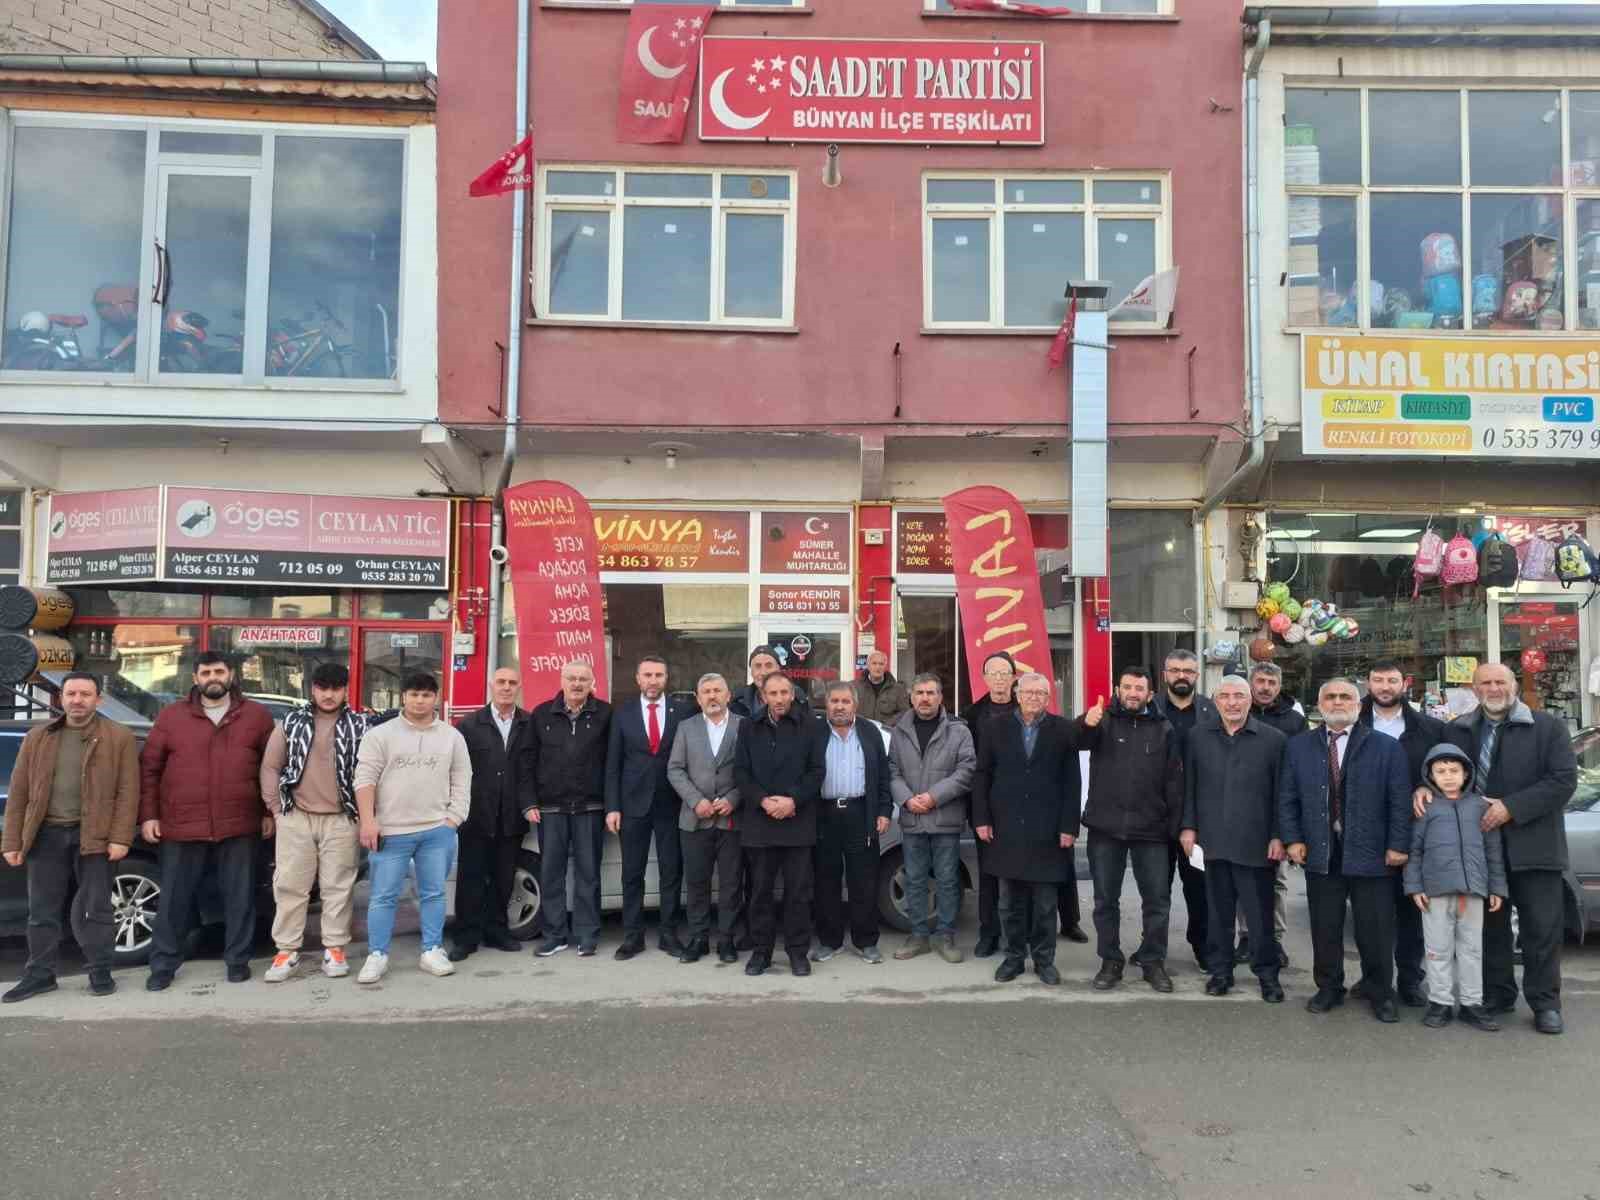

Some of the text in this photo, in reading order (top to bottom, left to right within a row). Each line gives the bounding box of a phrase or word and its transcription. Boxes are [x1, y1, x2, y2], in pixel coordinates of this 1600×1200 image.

[790, 47, 1033, 100] SAADET PARTİSİ
[793, 107, 1032, 134] BÜNYAN İLÇE TEŞKİLATI
[1318, 338, 1431, 387] ÜNAL
[1552, 402, 1585, 416] PVC
[1327, 428, 1466, 447] RENKLİ FOTOKOPİ
[1483, 428, 1495, 449] 0
[1502, 428, 1540, 449] 535
[1545, 429, 1583, 450] 379
[319, 511, 399, 533] CEYLAN
[172, 552, 260, 565] Alper CEYLAN
[620, 555, 649, 567] 863
[655, 555, 674, 568] 78
[679, 556, 698, 568] 57
[791, 551, 840, 560] MAHALLE
[175, 565, 255, 577] 0536 451 25 80
[279, 562, 343, 575] 712 05 09
[355, 559, 440, 572] Orhan CEYLAN
[786, 560, 847, 571] MUHTARLIĞI
[361, 571, 435, 583] 0535 283 20 70
[800, 588, 841, 600] KENDİR
[769, 602, 775, 610] 0
[240, 629, 321, 641] ANAHTARCI
